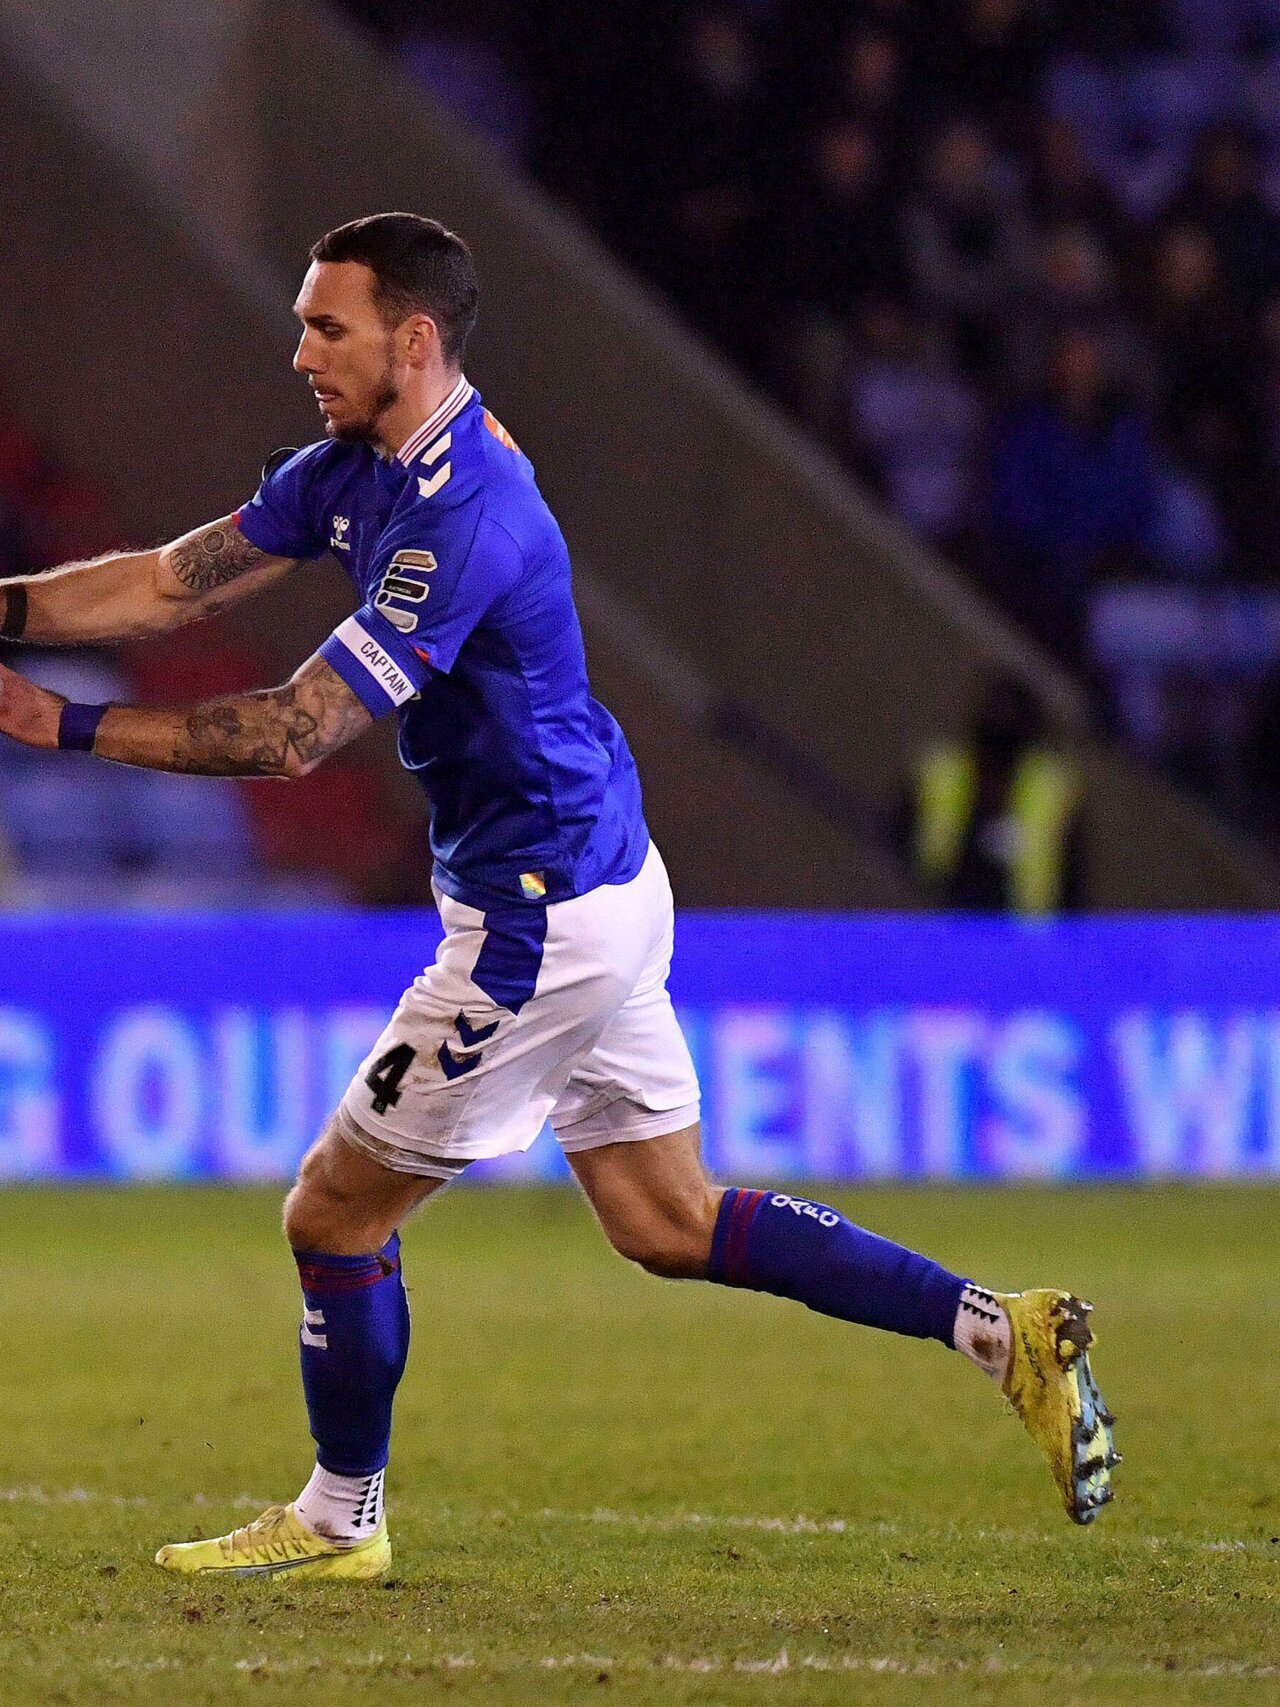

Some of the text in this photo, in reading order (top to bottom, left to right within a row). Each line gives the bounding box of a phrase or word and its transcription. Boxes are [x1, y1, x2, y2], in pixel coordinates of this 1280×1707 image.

[360, 640, 409, 697] CAPTAIN
[364, 1041, 418, 1117] 4
[1108, 1004, 1280, 1184] W
[770, 1194, 841, 1228] OAFC
